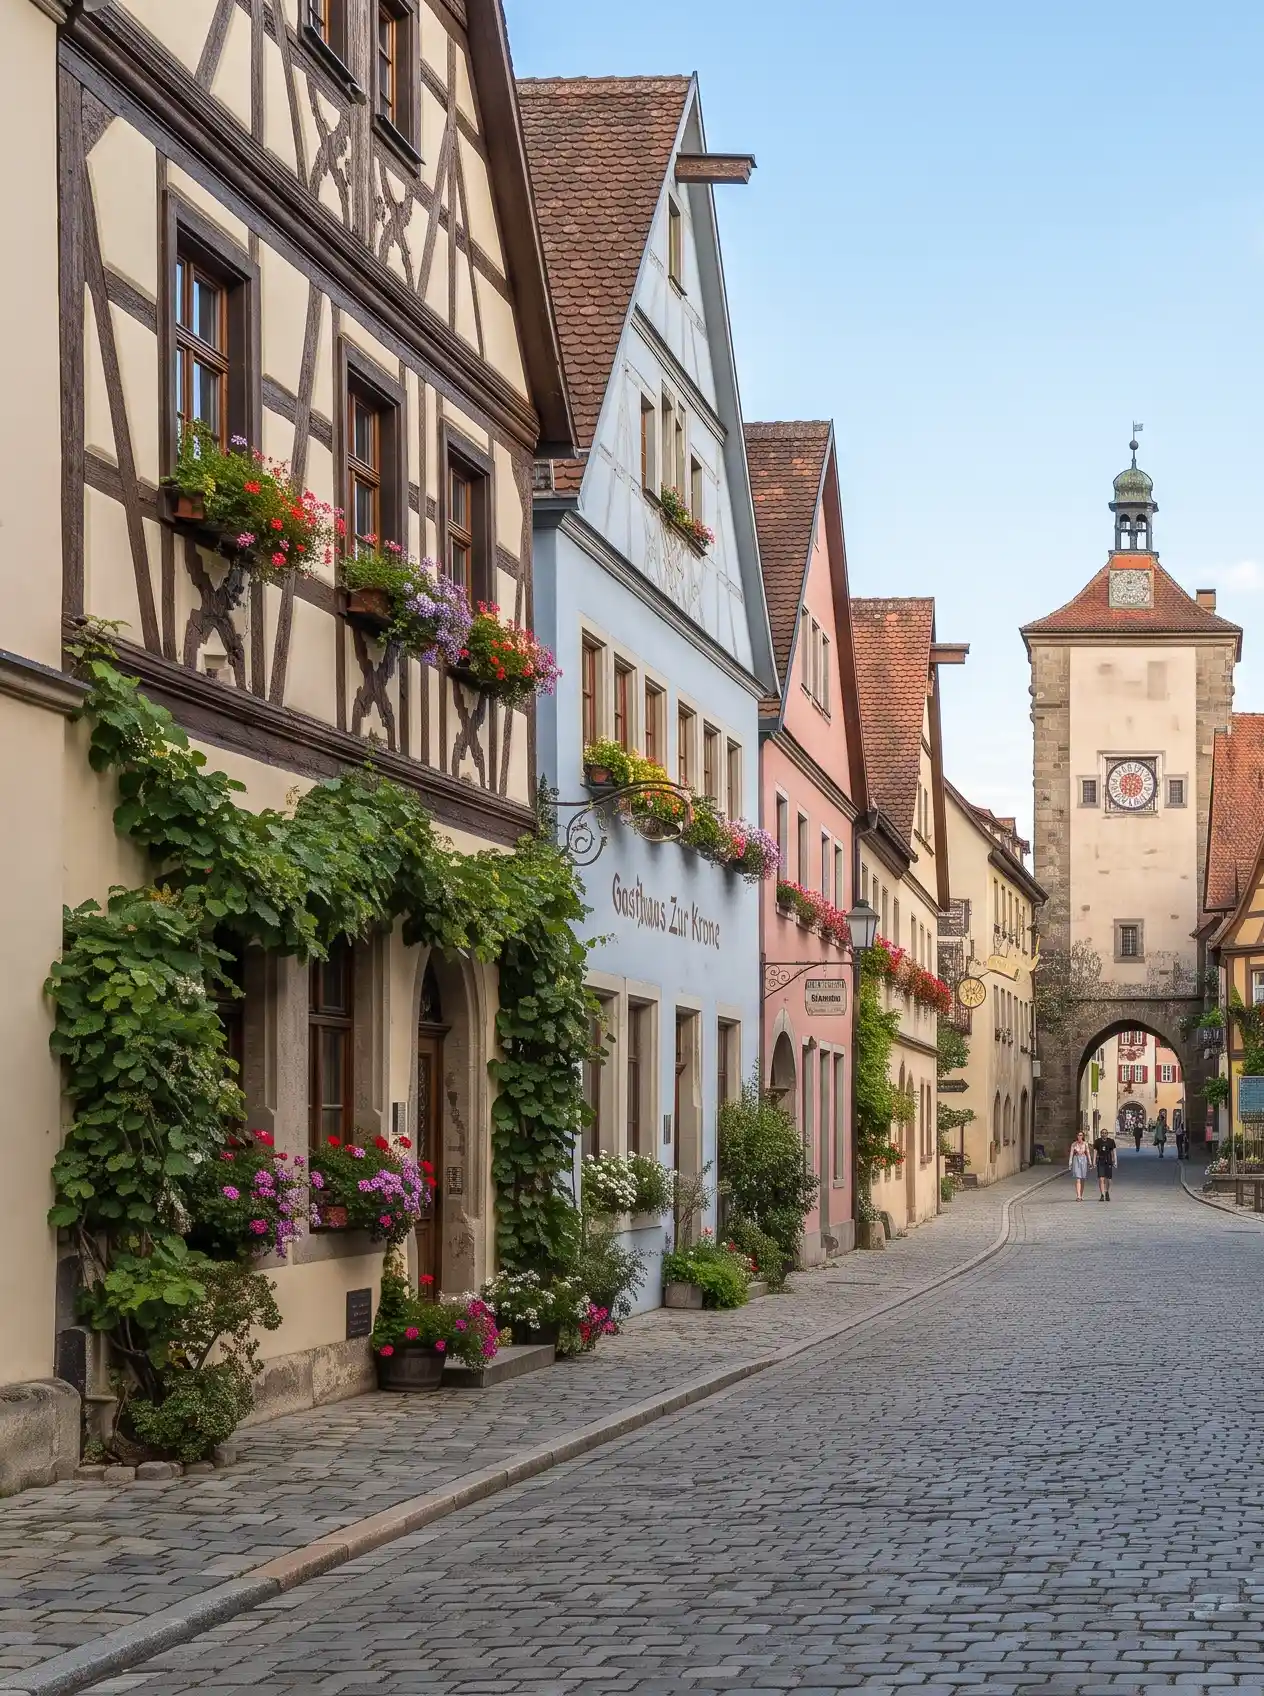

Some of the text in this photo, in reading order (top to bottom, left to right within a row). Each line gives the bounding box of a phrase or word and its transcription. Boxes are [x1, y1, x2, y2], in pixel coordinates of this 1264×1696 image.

[612, 872, 720, 950] Gasthaus Zur Krone
